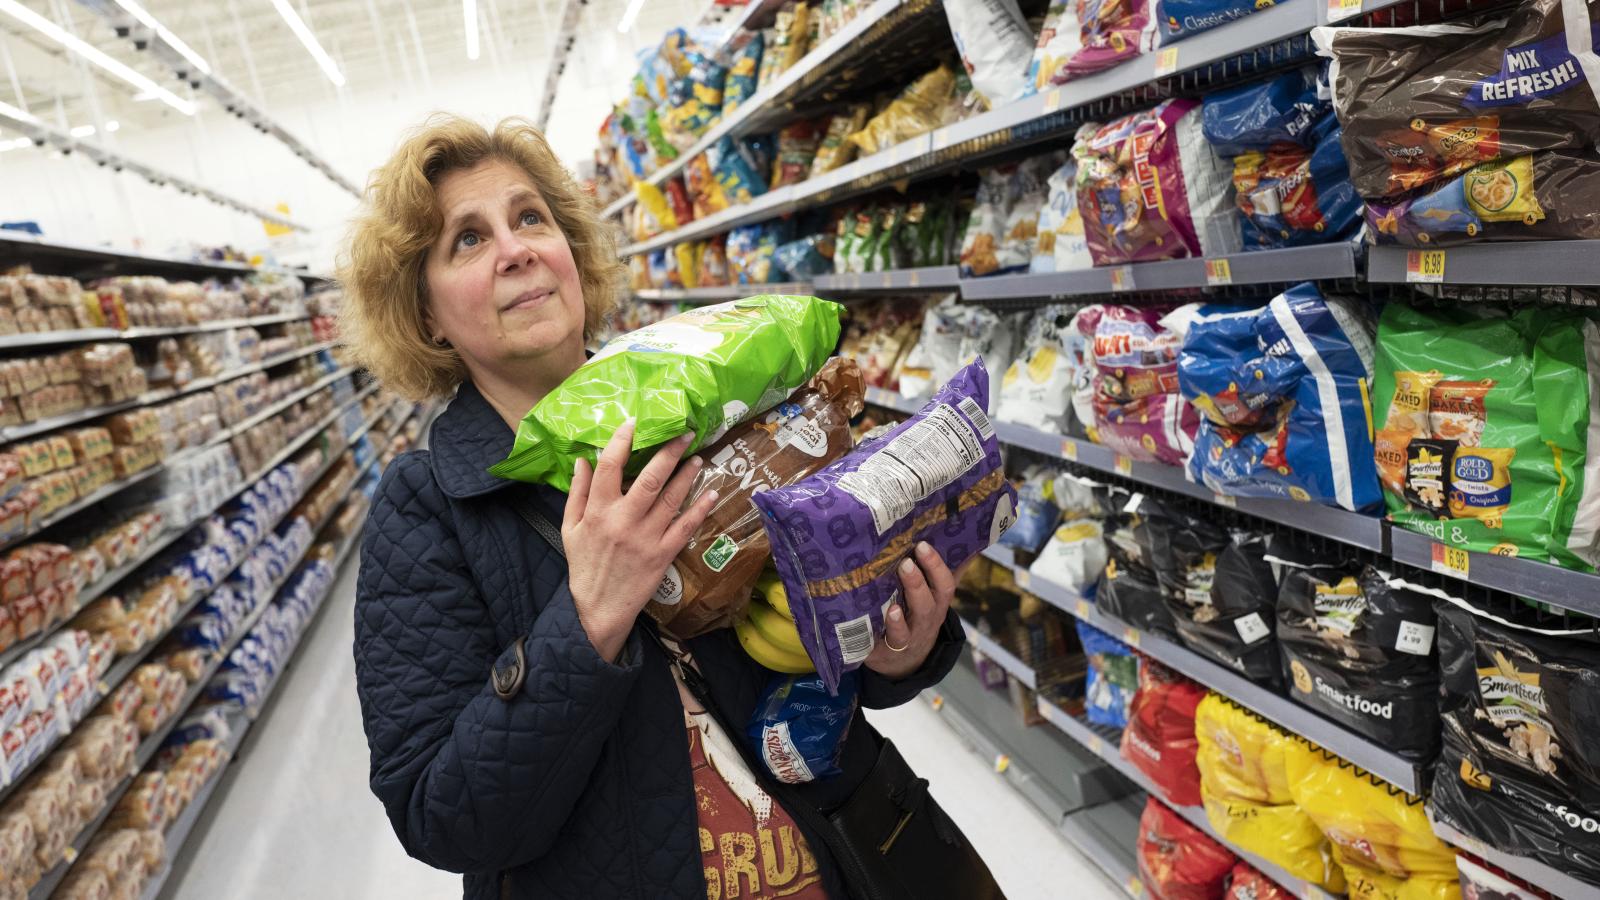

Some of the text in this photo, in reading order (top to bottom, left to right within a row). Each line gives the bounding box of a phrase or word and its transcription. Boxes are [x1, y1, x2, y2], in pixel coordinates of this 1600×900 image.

[1184, 12, 1223, 31] Classic
[1506, 49, 1541, 73] MIX
[1482, 59, 1578, 101] REFRESH!
[1424, 253, 1442, 274] 6.98
[1395, 392, 1421, 407] BAKED
[940, 404, 970, 433] Nutrition
[959, 448, 972, 466] 120
[1460, 457, 1486, 470] ROLD
[1457, 467, 1489, 481] GOLD
[1469, 494, 1500, 506] Original
[1405, 517, 1470, 544] aked &
[1449, 549, 1466, 571] 6.98
[1314, 676, 1394, 719] Smartfood
[1480, 676, 1546, 705] Smartfood
[1491, 707, 1519, 717] WHITE
[1469, 766, 1482, 783] 12
[1357, 879, 1375, 897] 12
